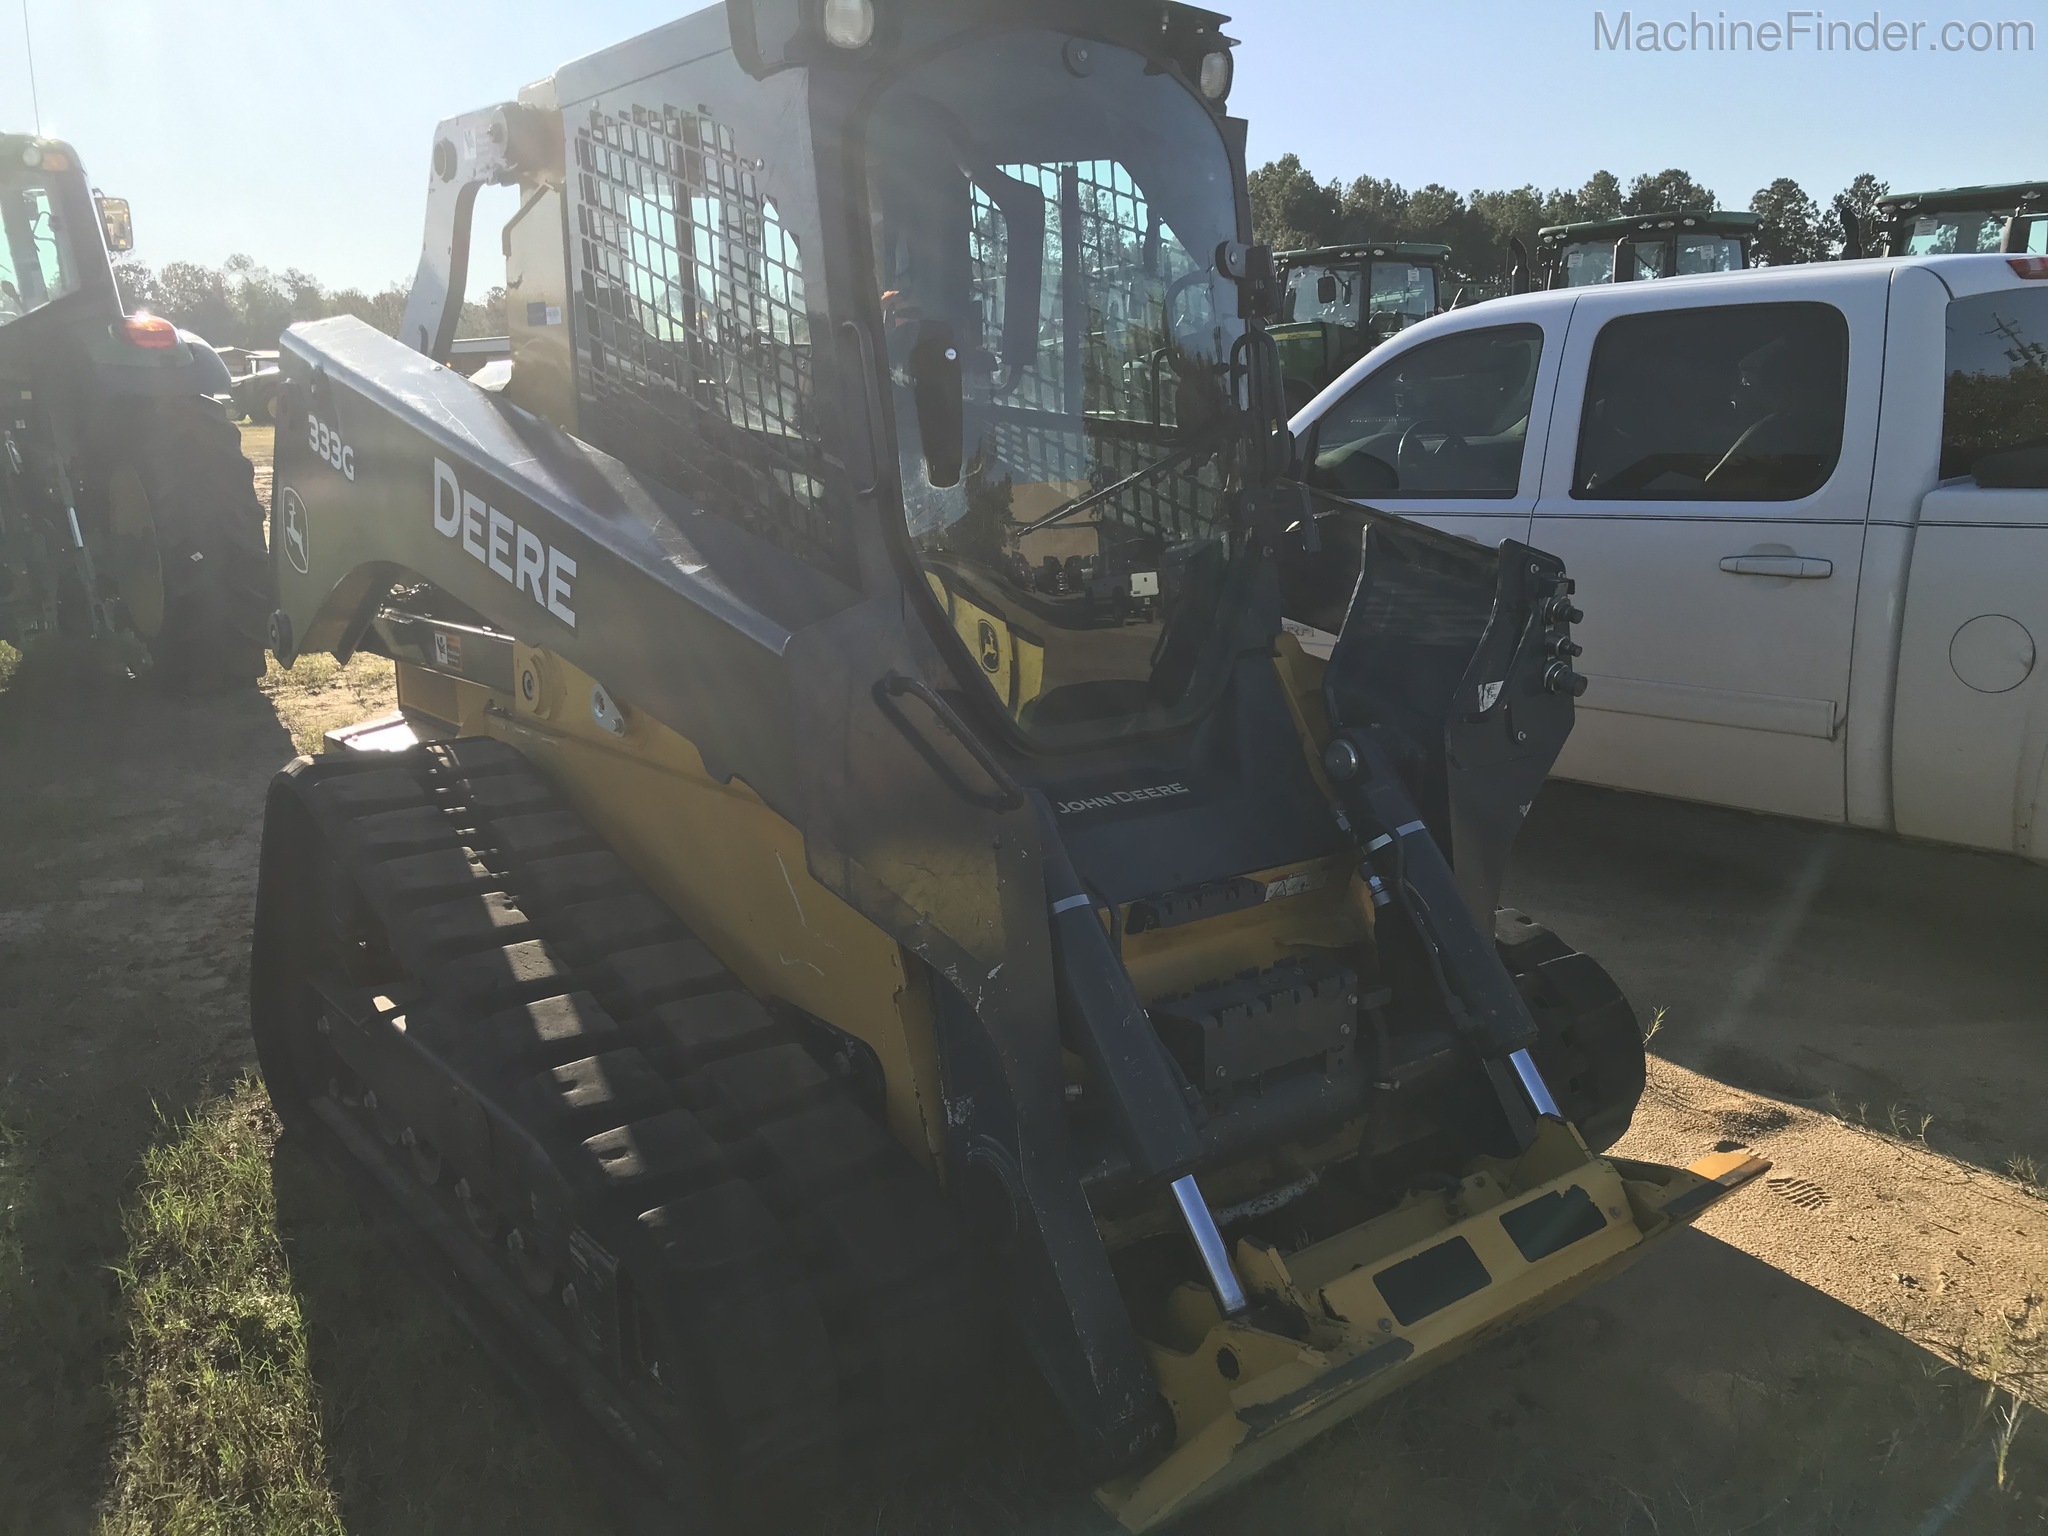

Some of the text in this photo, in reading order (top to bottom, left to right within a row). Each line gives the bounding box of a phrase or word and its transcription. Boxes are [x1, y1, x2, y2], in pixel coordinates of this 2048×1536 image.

[308, 414, 355, 481] 333G
[434, 456, 577, 628] DEERE
[1057, 782, 1190, 814] JOHN DEERE
